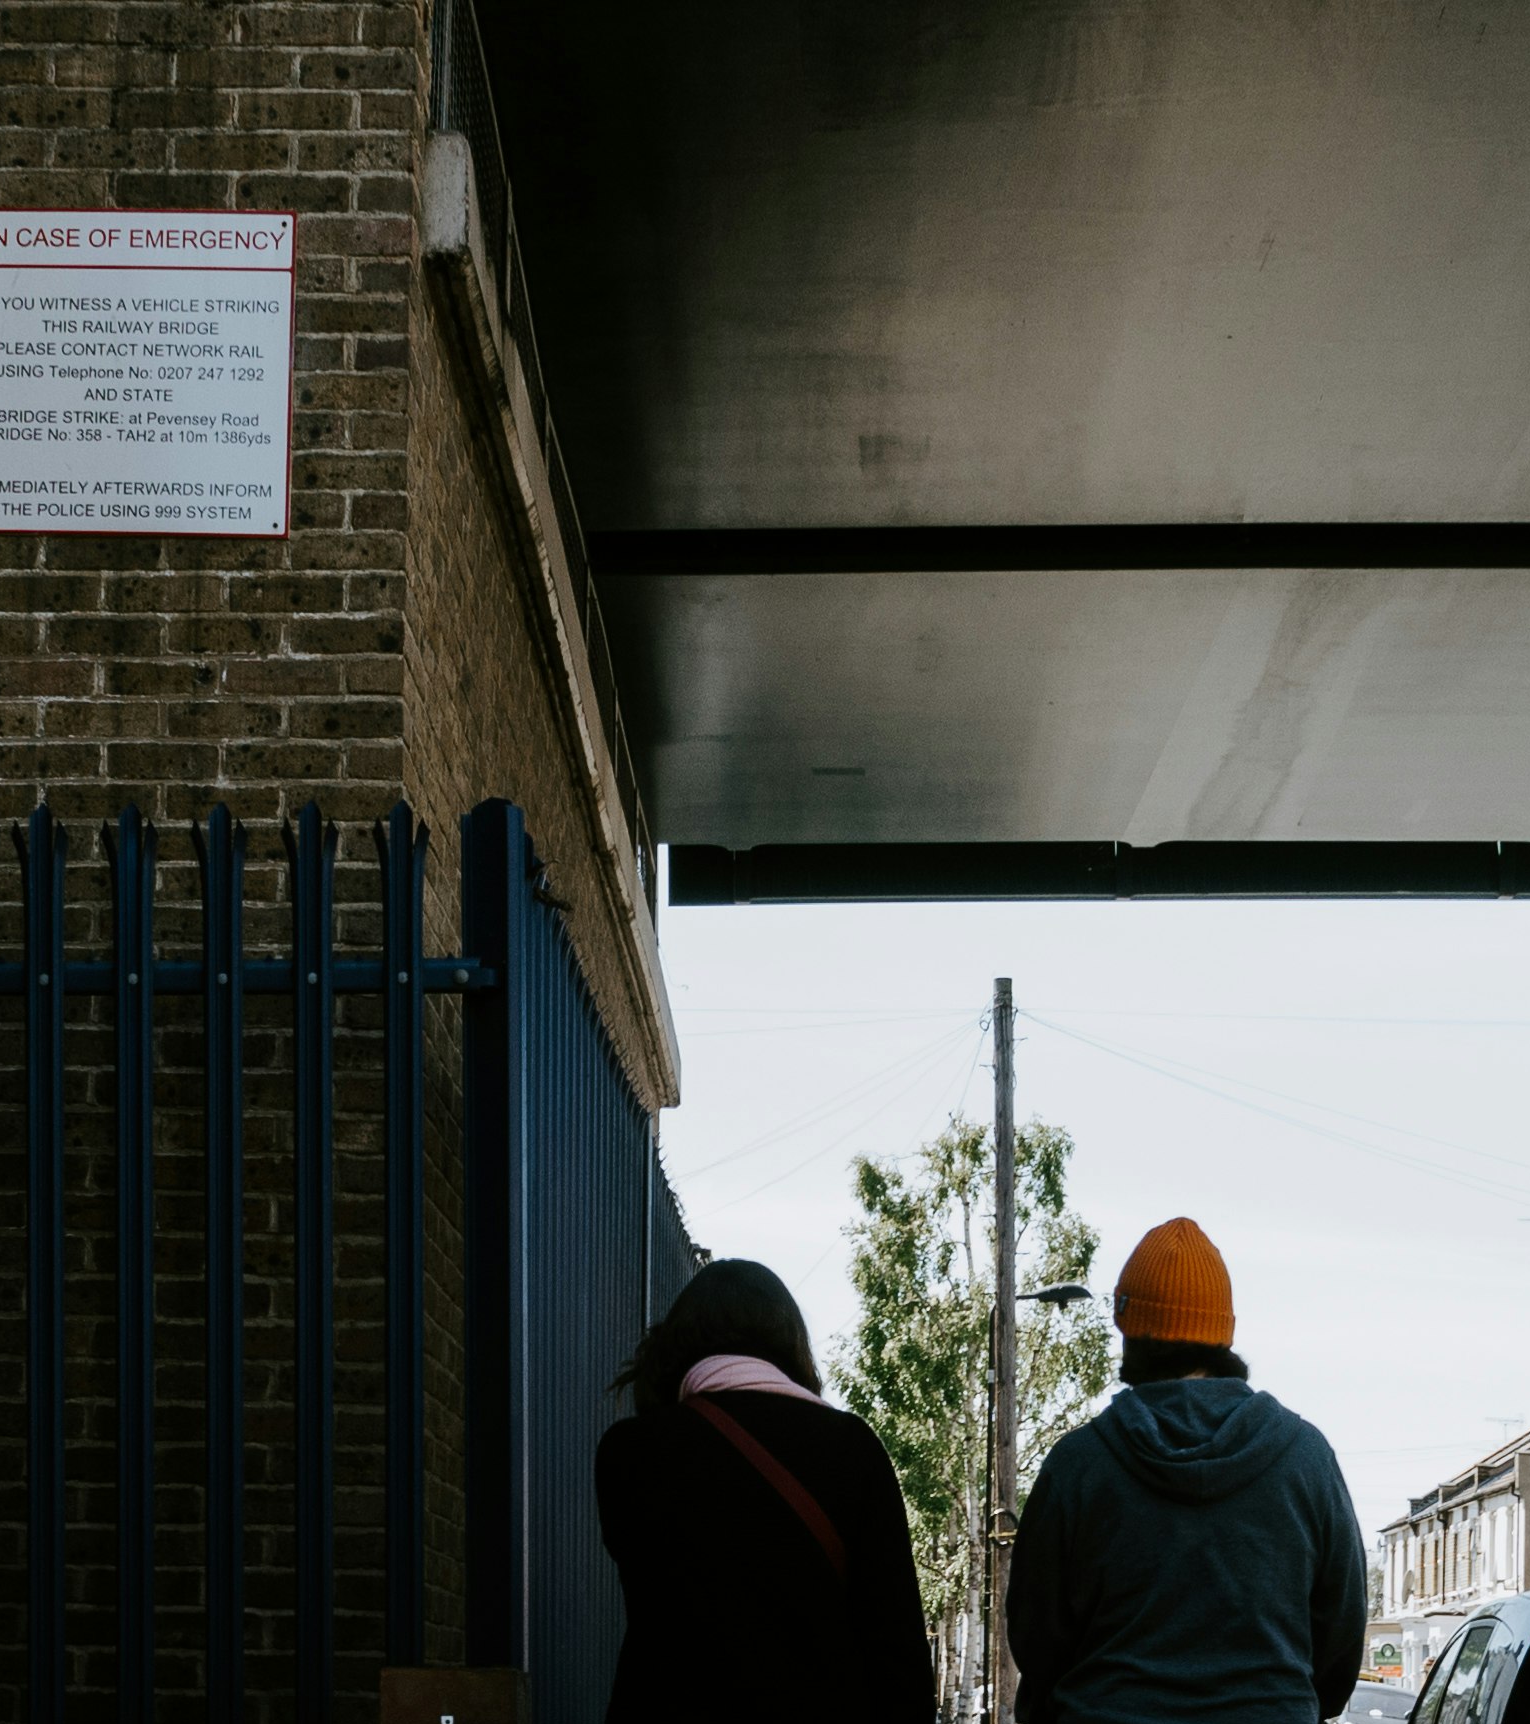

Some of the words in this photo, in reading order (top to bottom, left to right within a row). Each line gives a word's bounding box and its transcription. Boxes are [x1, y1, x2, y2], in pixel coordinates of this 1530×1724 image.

[16, 228, 80, 247] CASE
[89, 229, 121, 247] OF
[130, 229, 285, 250] EMERGENCY
[1, 297, 34, 310] YOU
[40, 298, 111, 311] WITNESS
[116, 299, 126, 311] A
[132, 299, 199, 312] VEHICLE
[205, 300, 279, 313] STRIKING
[42, 320, 77, 333] THIS
[83, 320, 153, 334] RAILWAY
[159, 322, 218, 335] BRIDGE
[62, 343, 138, 356] CONTACT
[143, 344, 223, 357] NETWORK
[229, 345, 263, 358] RAIL
[49, 365, 123, 381] Telephone
[129, 366, 152, 379] No:
[158, 367, 192, 379] 0207
[198, 367, 223, 380] 247
[231, 368, 264, 381] 1292
[84, 388, 117, 401] AND
[123, 389, 173, 402] STATE
[63, 411, 123, 424] STRIKE:
[129, 413, 142, 424] at
[147, 412, 216, 428] Pevensey
[222, 413, 258, 426] Road
[48, 428, 72, 441] No:
[77, 429, 102, 441] 358
[117, 429, 155, 442] TAH2
[160, 431, 173, 442] at
[179, 431, 207, 443] 10m
[215, 431, 271, 447] 1386yds
[93, 481, 204, 496] AFTERWARDS
[210, 484, 271, 497] INFORM
[1, 503, 32, 516] THE
[38, 503, 95, 517] POLICE
[100, 504, 150, 518] USING
[155, 505, 181, 518] 999
[186, 506, 251, 519] SYSTEM
